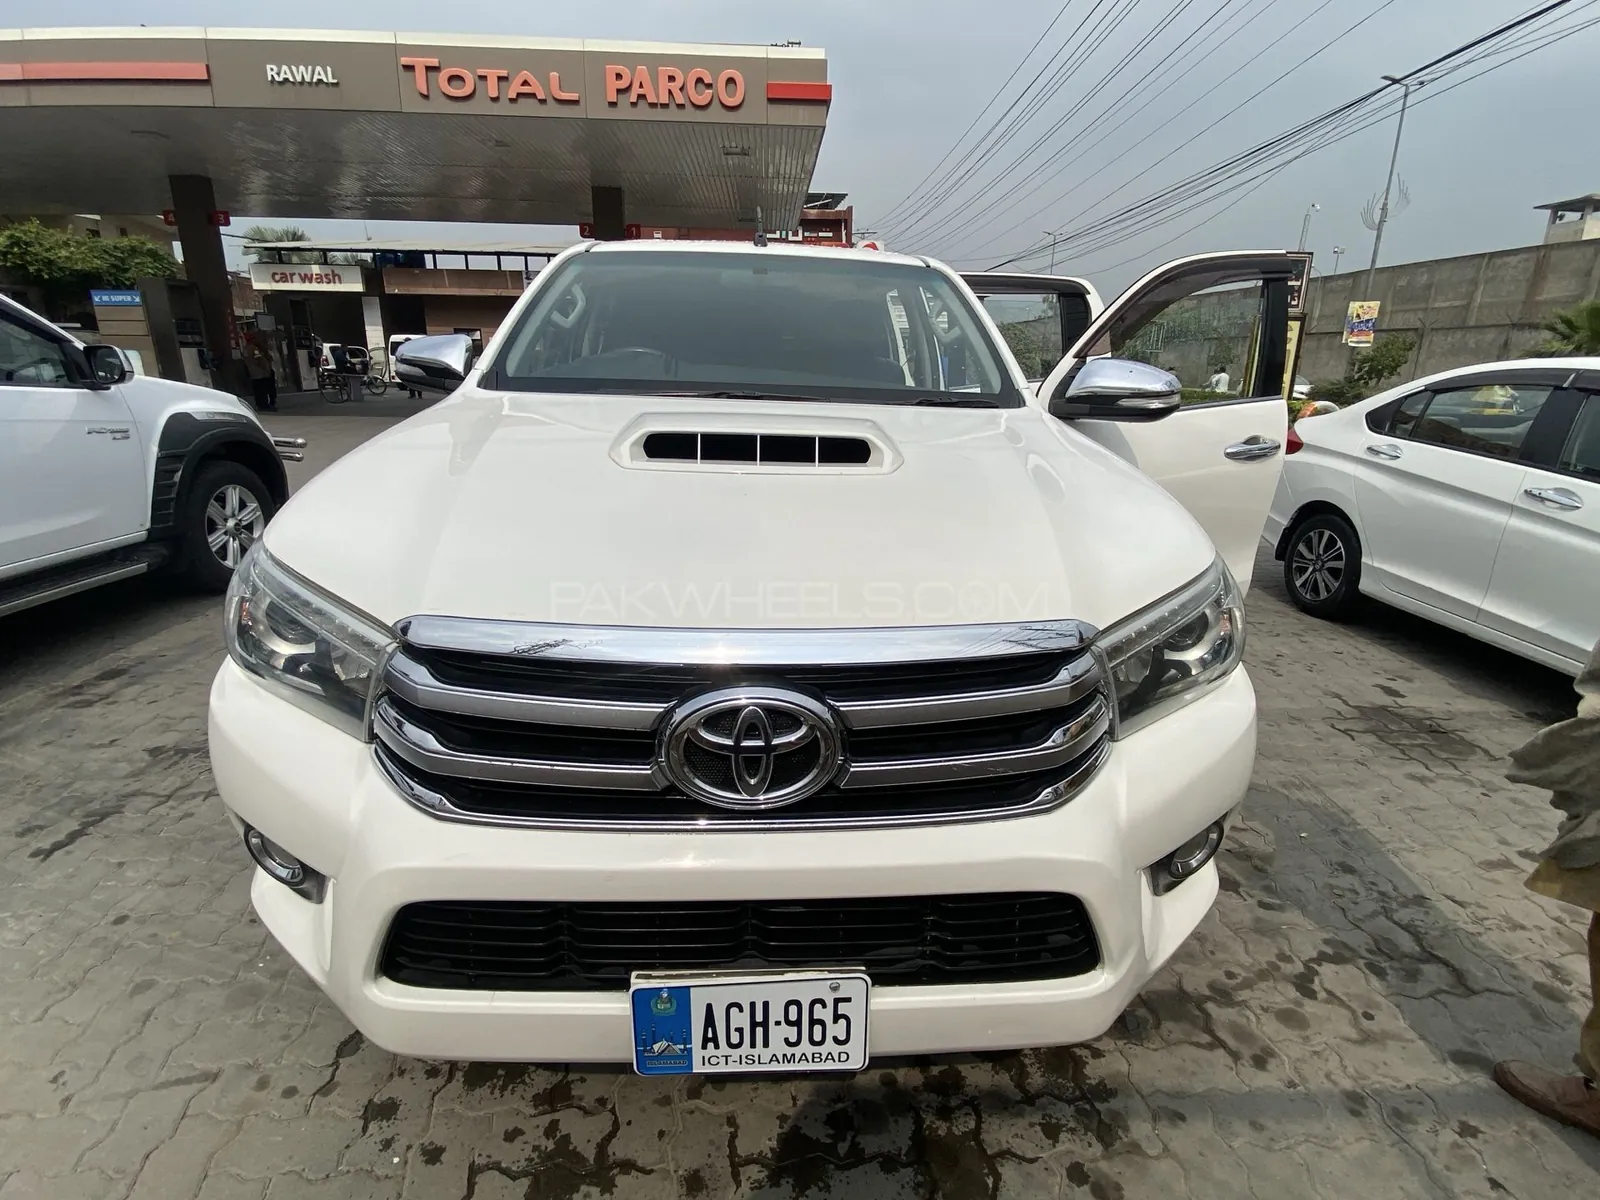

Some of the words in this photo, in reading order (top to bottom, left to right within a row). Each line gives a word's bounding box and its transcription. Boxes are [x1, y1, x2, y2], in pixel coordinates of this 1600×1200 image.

[266, 63, 339, 85] RAWAL
[400, 57, 580, 102] TOTAL
[605, 64, 745, 108] PARCO
[218, 214, 225, 223] 3
[583, 226, 589, 236] 2
[271, 271, 297, 284] car
[298, 269, 343, 284] wash
[701, 996, 853, 1050] AGH-965
[701, 1051, 850, 1066] ICT-ISLAMABAD
